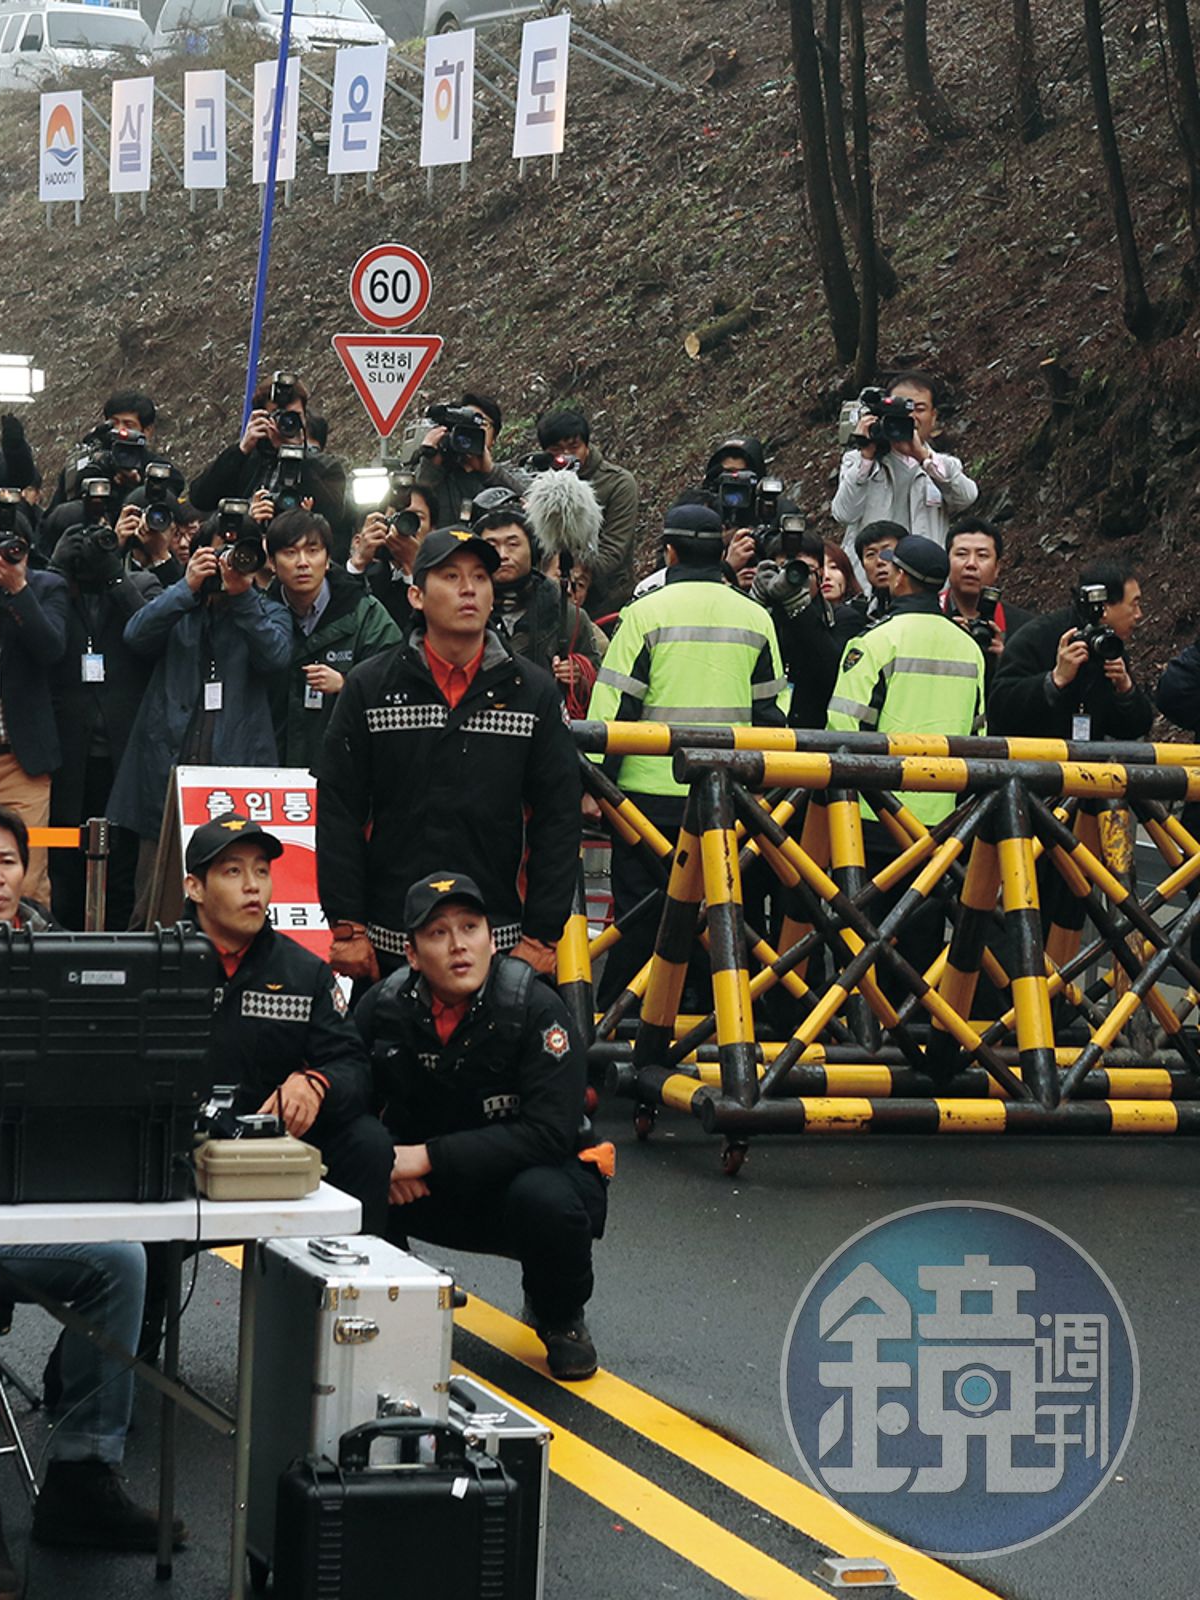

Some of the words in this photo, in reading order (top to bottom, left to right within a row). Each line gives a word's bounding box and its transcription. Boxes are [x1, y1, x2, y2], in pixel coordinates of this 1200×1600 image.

[369, 269, 412, 304] 60
[364, 351, 413, 370] 천천히
[368, 371, 406, 384] SLOW
